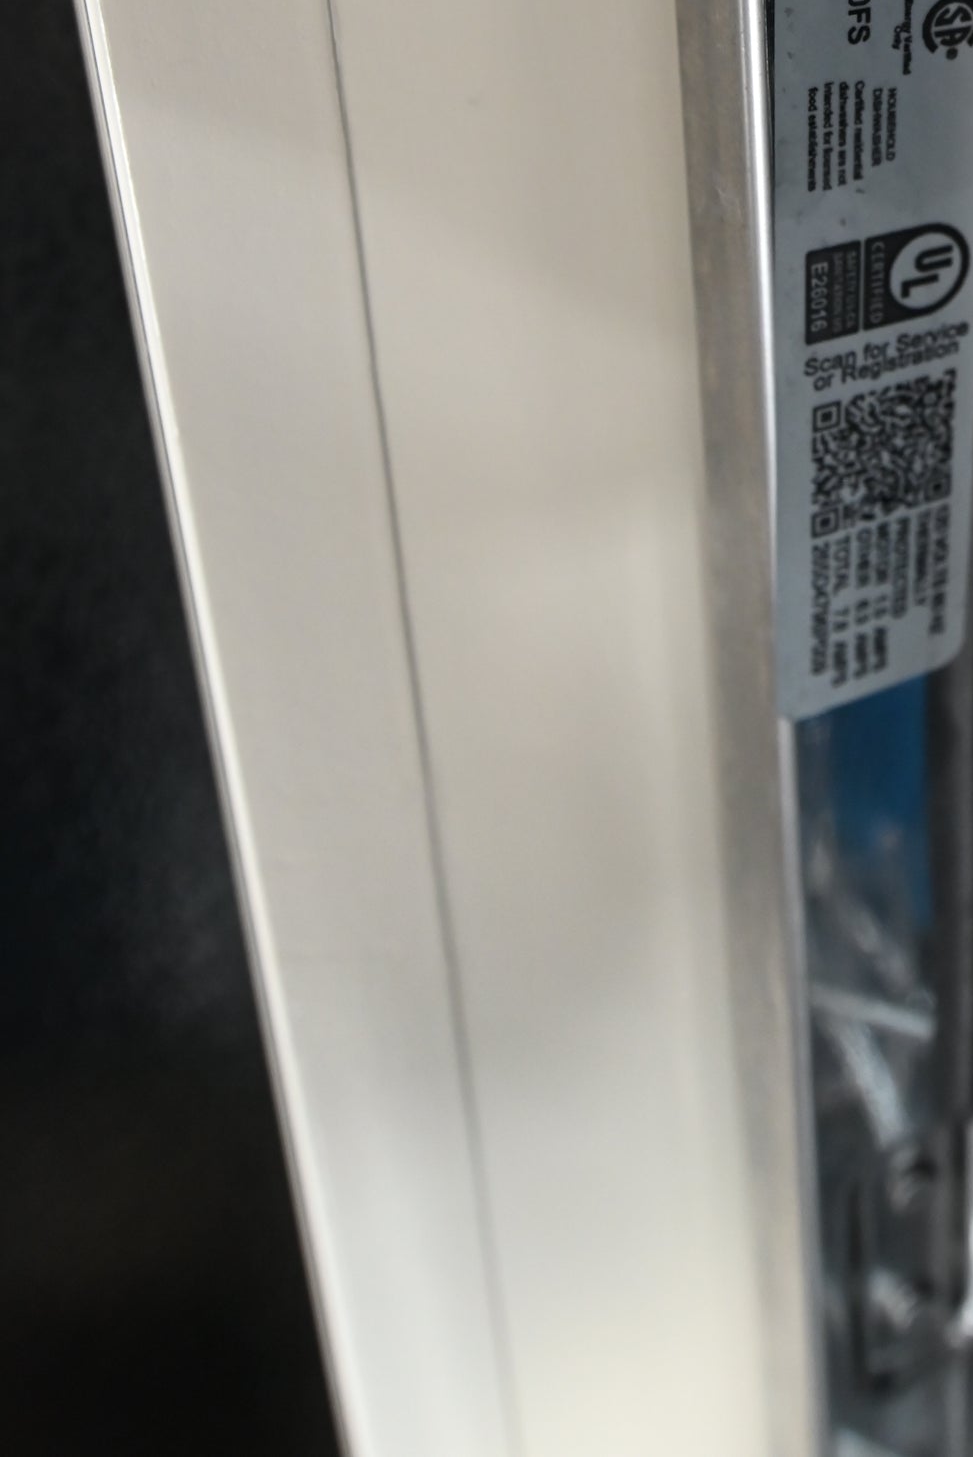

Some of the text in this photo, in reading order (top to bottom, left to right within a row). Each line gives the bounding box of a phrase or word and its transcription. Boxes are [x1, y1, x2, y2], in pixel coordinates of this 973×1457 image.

[871, 88, 884, 167] DISHWASHER
[886, 87, 897, 162] HOUSEHOLD
[810, 262, 829, 333] E26016
[869, 241, 885, 324] CERTIFIED
[901, 245, 953, 299] UL
[804, 322, 969, 377] Scan for Service
[812, 341, 960, 392] or Registration
